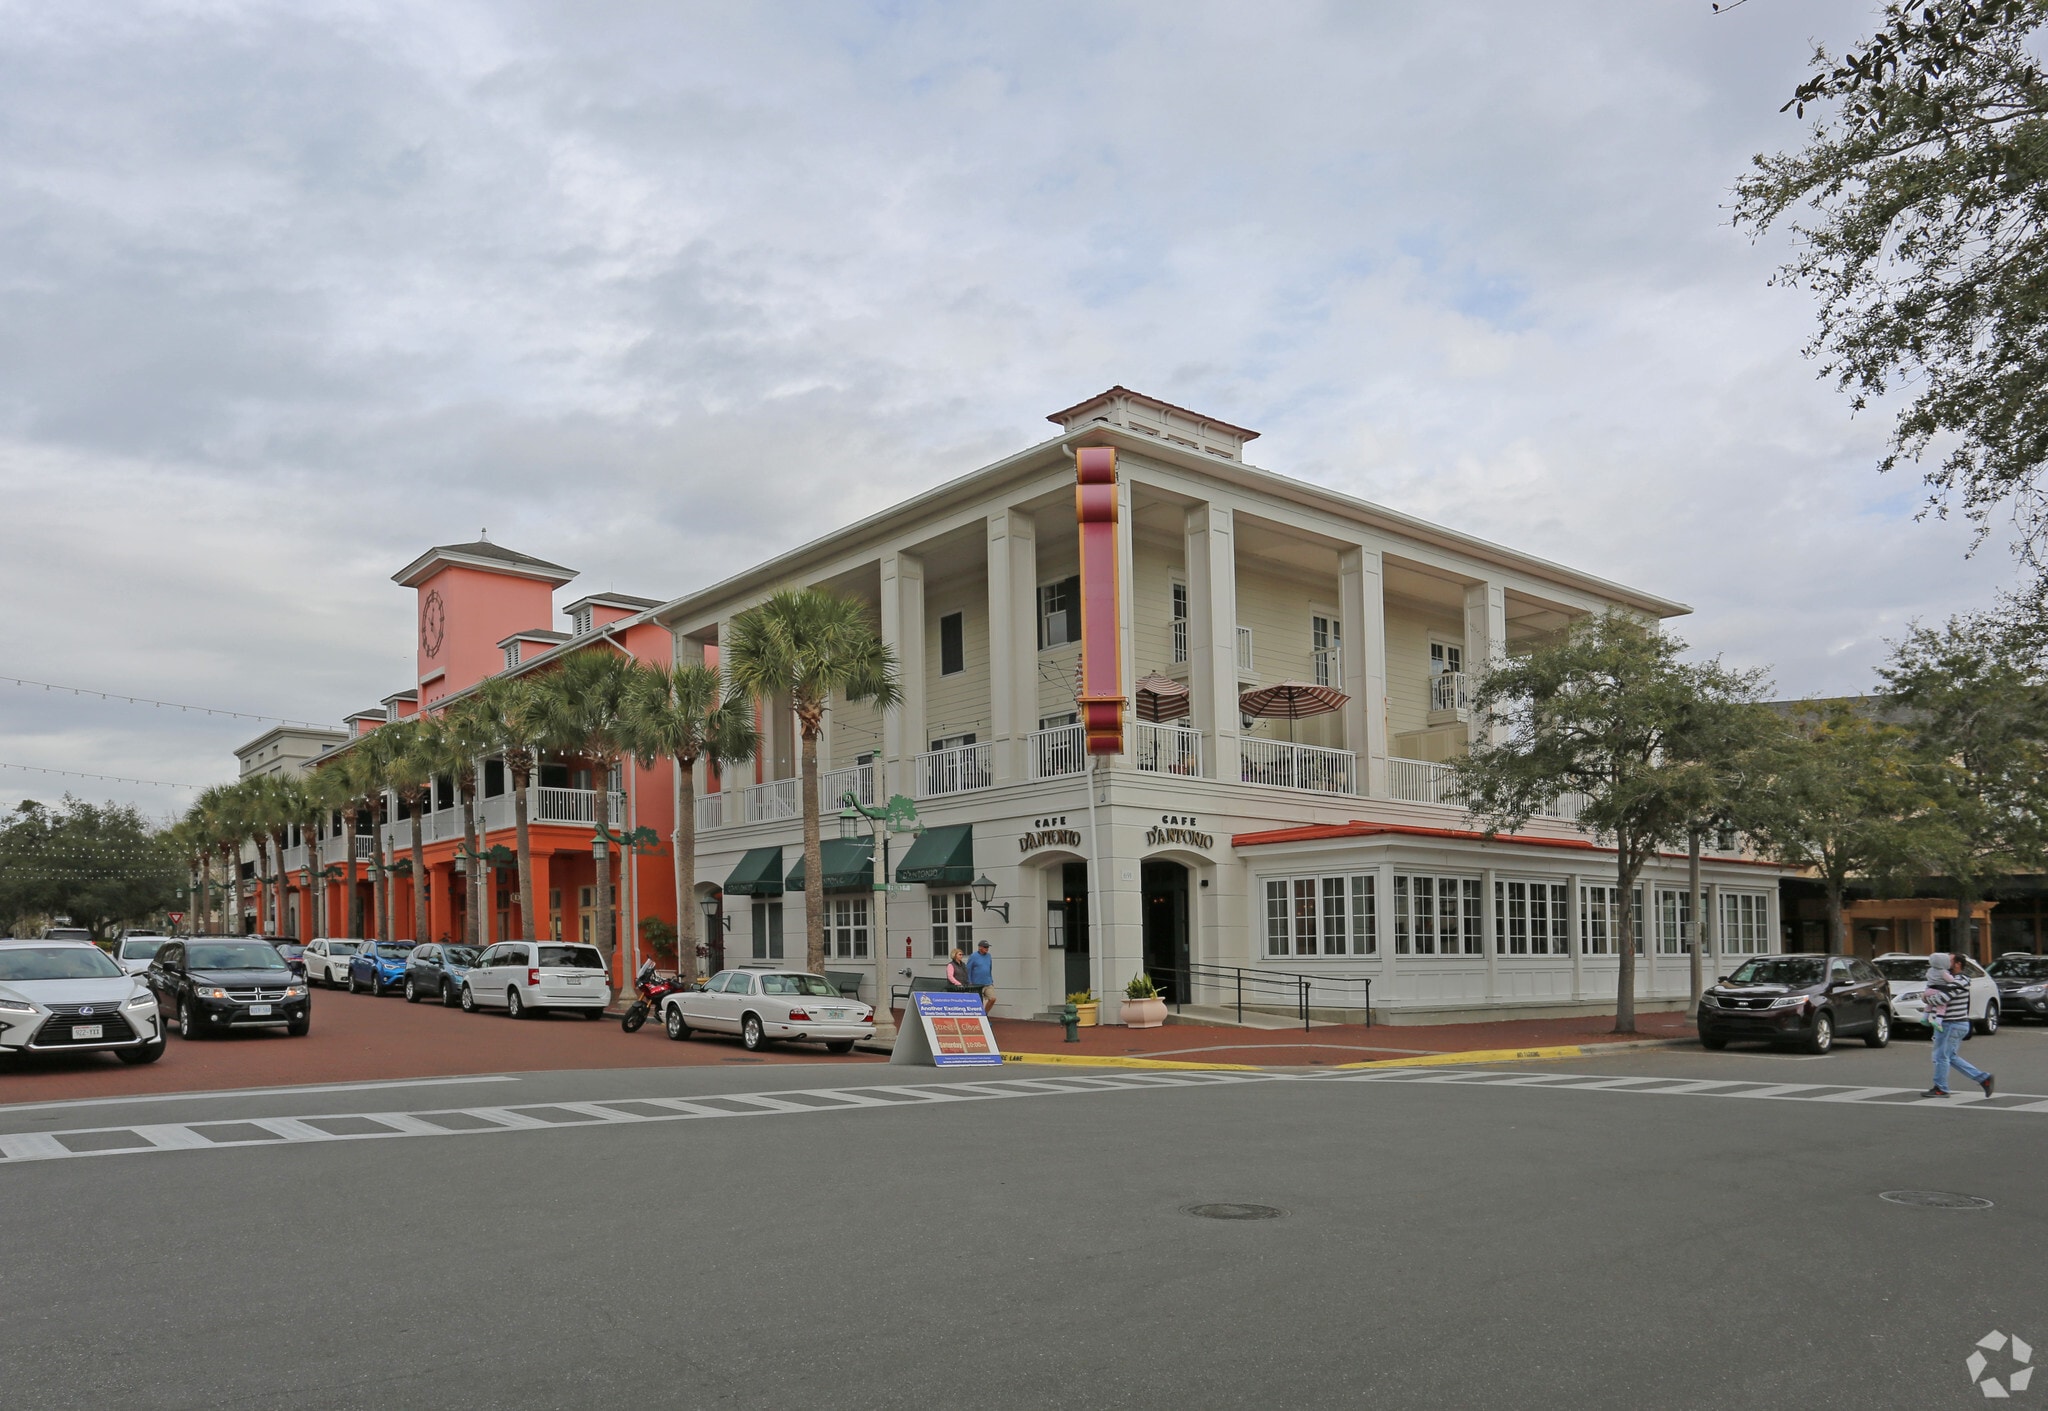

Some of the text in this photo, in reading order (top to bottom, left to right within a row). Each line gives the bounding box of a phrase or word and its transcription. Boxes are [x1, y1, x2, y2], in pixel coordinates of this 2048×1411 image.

[1035, 816, 1066, 828] CAFE
[1161, 815, 1196, 826] CAFE
[1018, 829, 1081, 852] D'ANTONIO
[1146, 825, 1213, 849] D'ANTONIO
